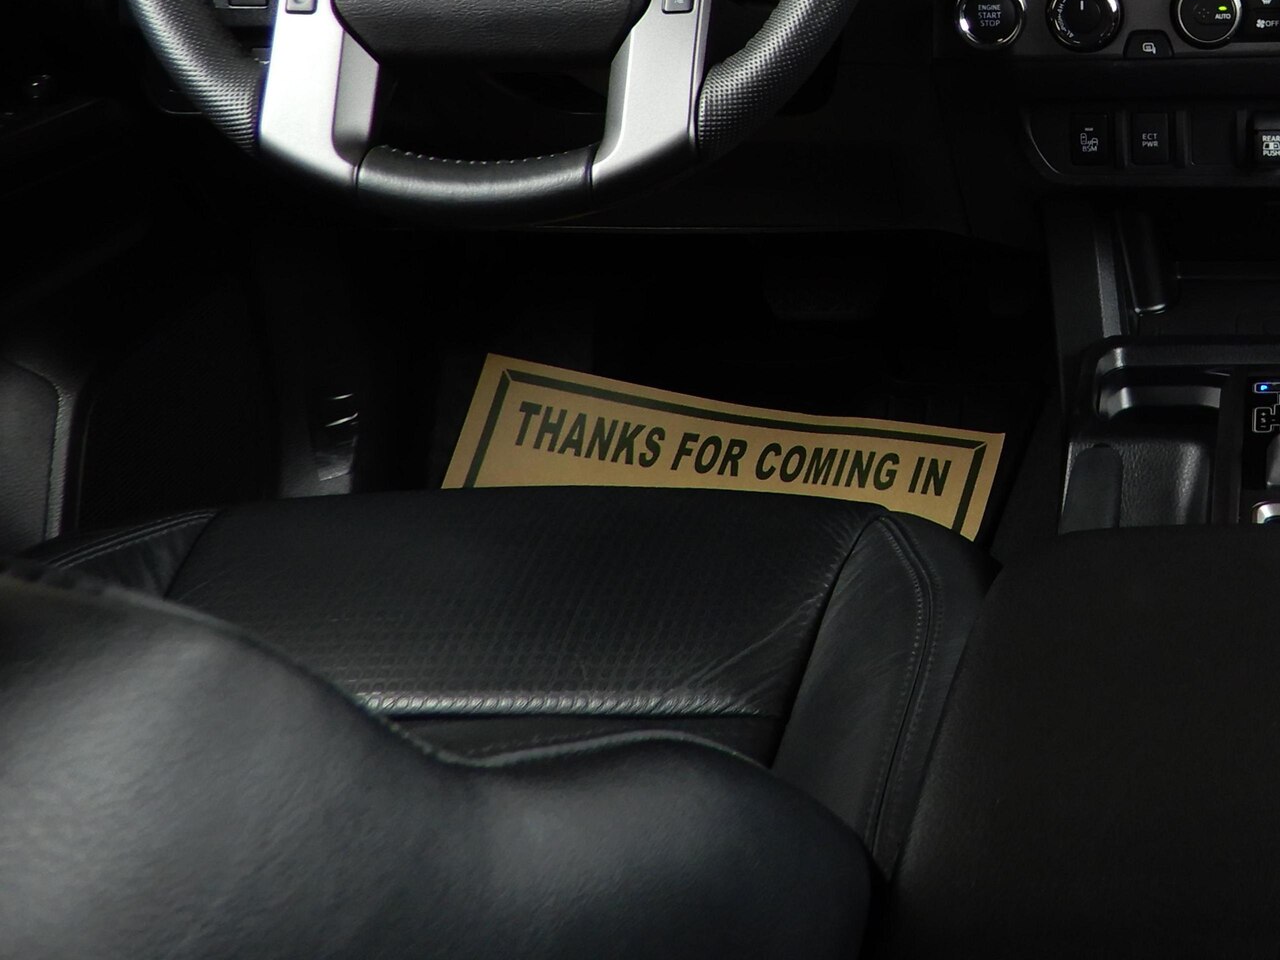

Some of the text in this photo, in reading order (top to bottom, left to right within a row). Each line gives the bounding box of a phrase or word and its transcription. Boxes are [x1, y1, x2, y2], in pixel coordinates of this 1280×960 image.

[514, 401, 952, 497] THANKS FOR COMING IN
